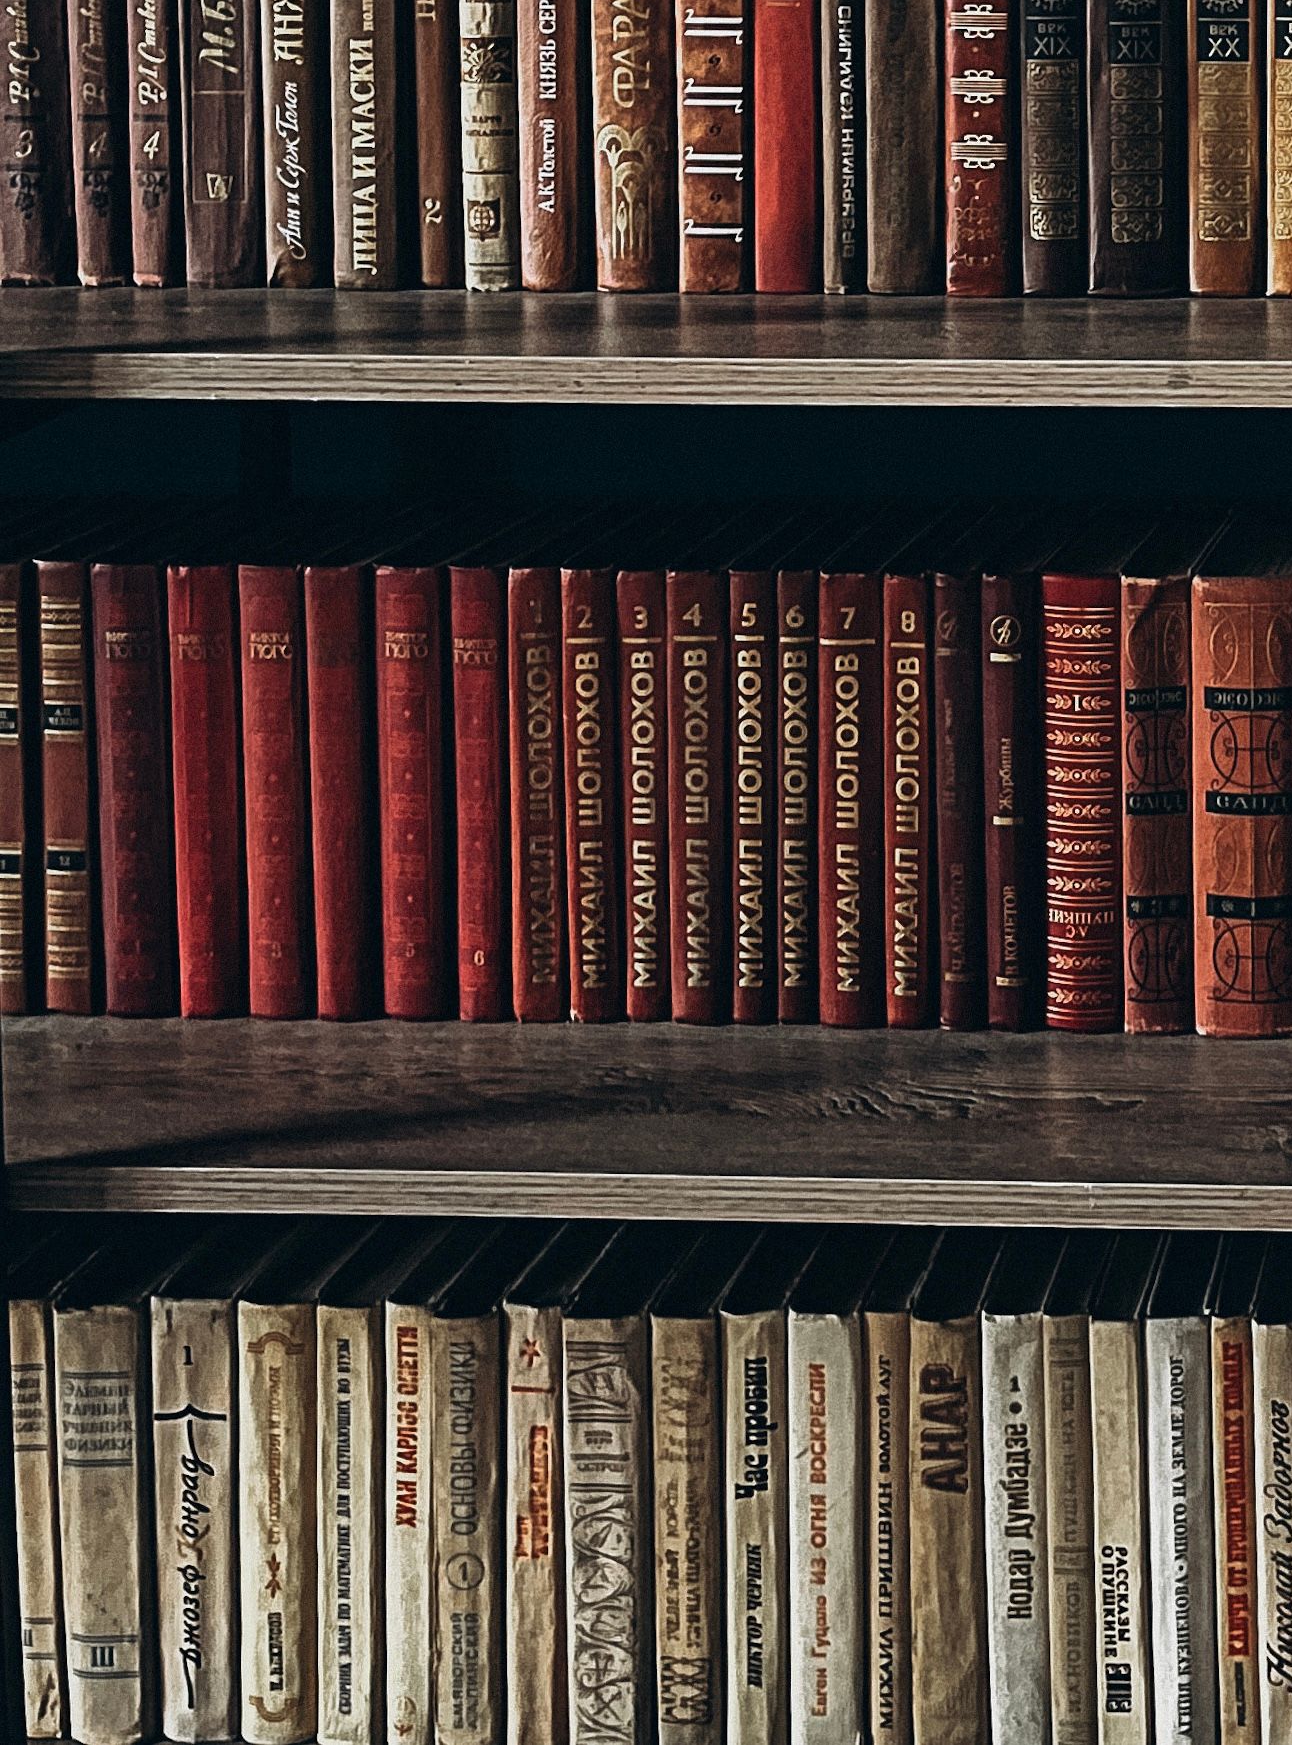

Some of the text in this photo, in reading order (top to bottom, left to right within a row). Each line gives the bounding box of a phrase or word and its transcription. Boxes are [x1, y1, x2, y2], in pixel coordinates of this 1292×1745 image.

[539, 39, 556, 99] КНЯЗЬ
[1208, 38, 1240, 57] XX
[143, 131, 160, 159] 4
[279, 137, 308, 189] Серж
[350, 38, 378, 275] ЛИЦА И МАСКИ
[998, 737, 1015, 810] Журбины
[574, 651, 607, 988] МИХАИЛ ШОЛОХОВ
[338, 1379, 350, 1394] ВО
[878, 1355, 892, 1388] ЛУГ
[1170, 1355, 1186, 1410] ДОРОГ
[337, 1400, 352, 1490] ПОСТУПАЮЩИХ
[397, 1402, 418, 1474] КАРЛОС
[450, 1341, 478, 1536] ОСНОВЫ ФИЗИКИ
[919, 1364, 969, 1494] АНАР
[1171, 1412, 1186, 1470] ЗЕМЛЕ
[338, 1494, 351, 1518] ДЛЯ
[397, 1479, 417, 1528] ХУАН
[809, 1364, 827, 1585] ИЗ ОГНЯ ВОСКРЕСЛИ
[1173, 1475, 1186, 1498] НА
[878, 1482, 893, 1618] ПРИШВИН
[1000, 1423, 1036, 1620] Нодар Думбадзе
[1173, 1503, 1188, 1560] МНОГО
[337, 1524, 351, 1599] МАТЕМАТИКЕ
[1117, 1546, 1128, 1642] РАССКАЗЫ
[338, 1604, 350, 1620] ПО
[1102, 1545, 1116, 1658] О ПУШКИНЕ
[1175, 1574, 1192, 1676] КУЗНЕЦОВА
[338, 1625, 351, 1657] ЗАДАЧ
[748, 1616, 762, 1688] ВИКТОР
[338, 1662, 352, 1715] СБОРНИК
[879, 1628, 894, 1730] МИХАИЛ
